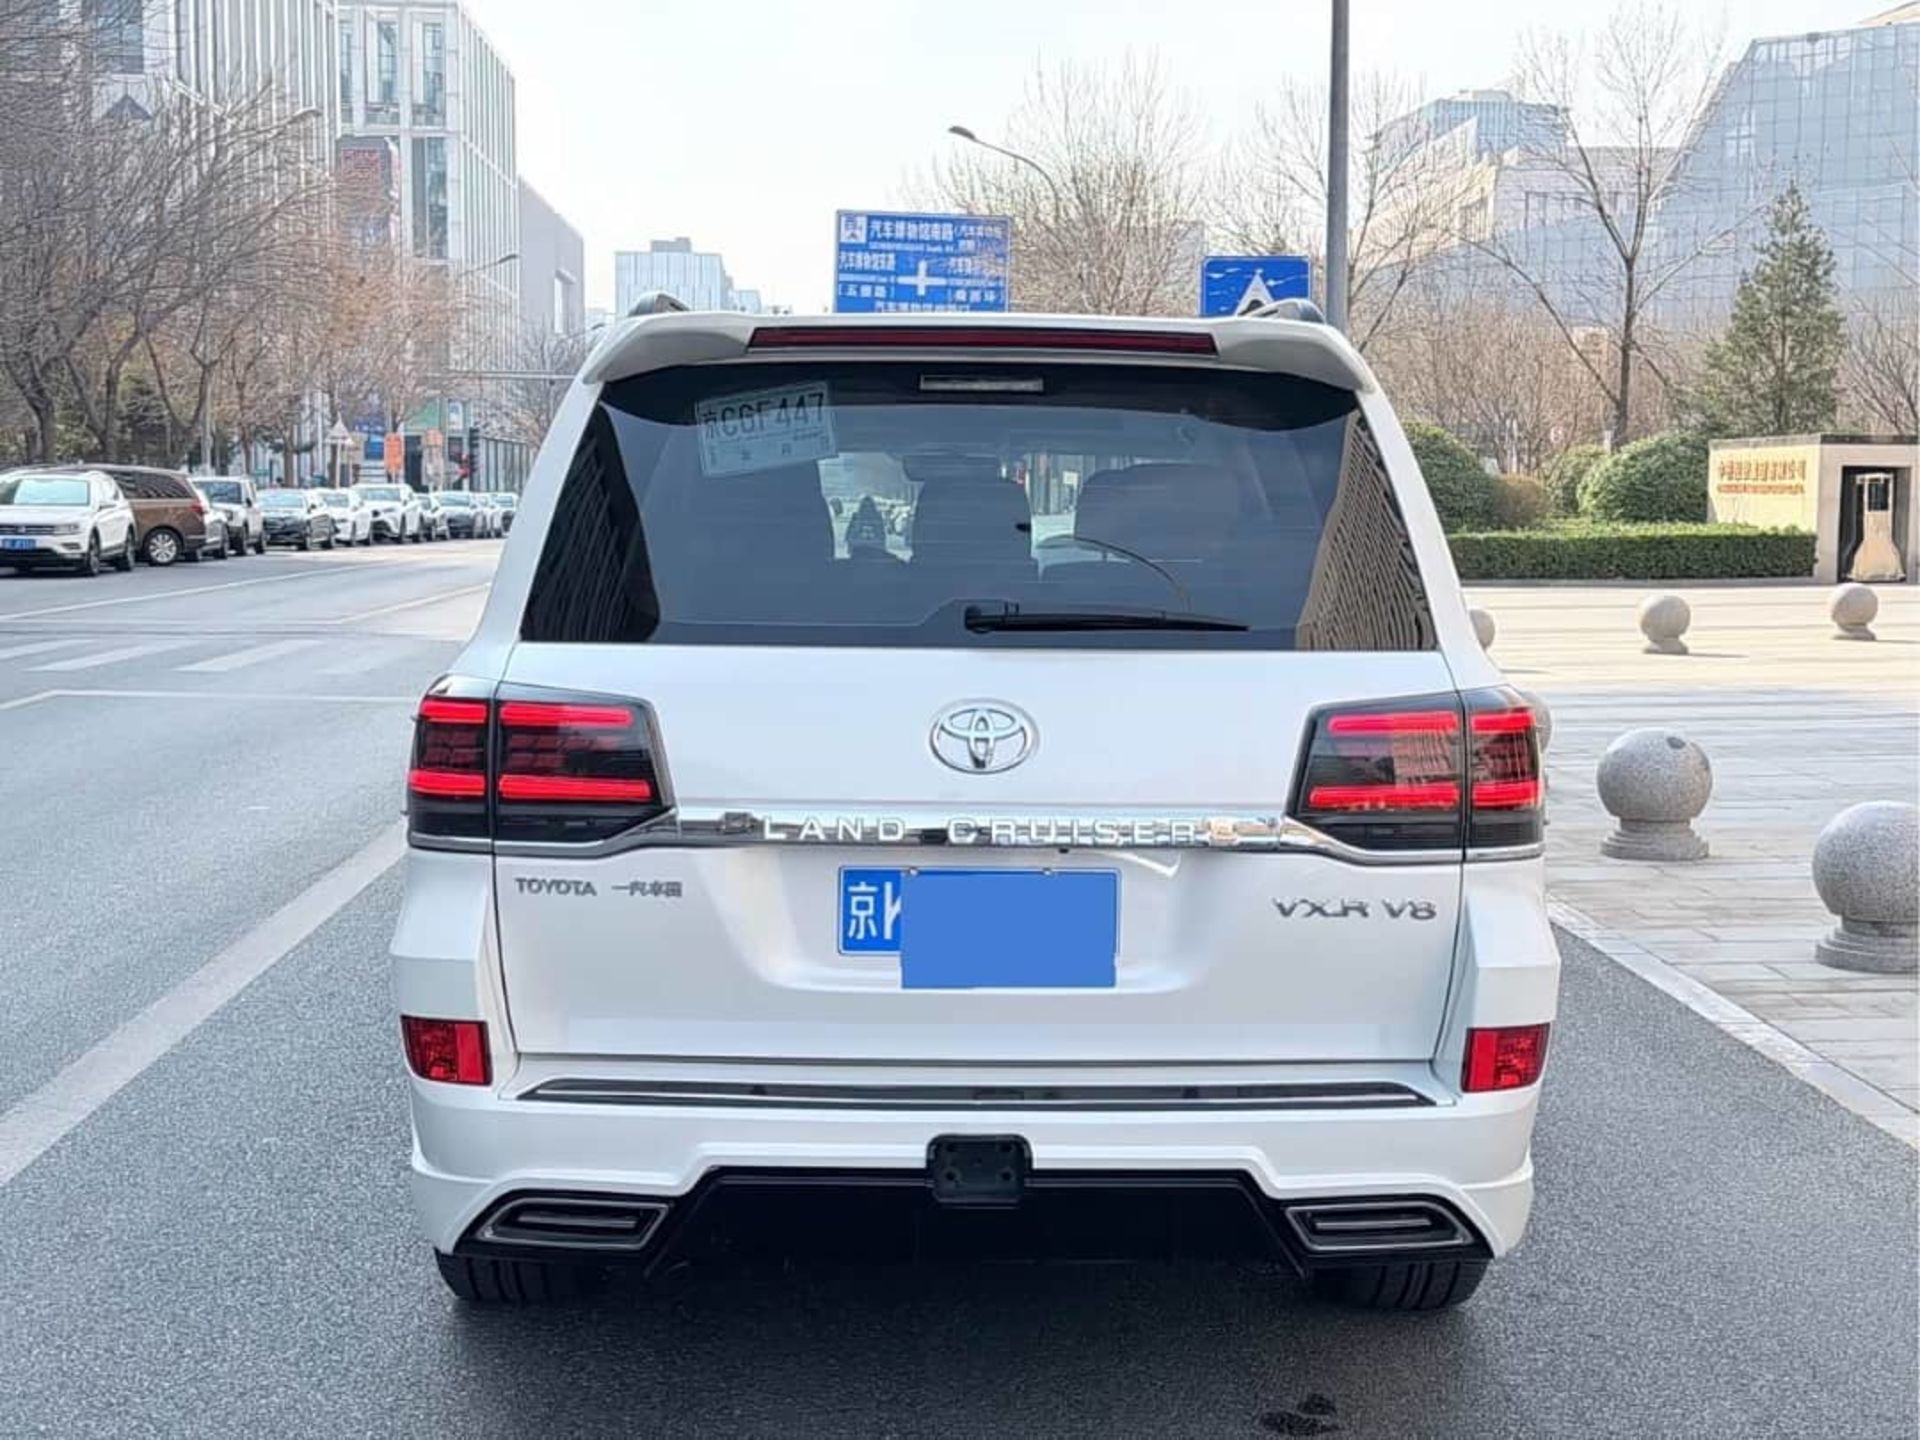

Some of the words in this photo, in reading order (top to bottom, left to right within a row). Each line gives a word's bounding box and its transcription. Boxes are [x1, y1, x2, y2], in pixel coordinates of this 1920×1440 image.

[763, 815, 906, 842] LAND
[947, 816, 1198, 847] CRUISER
[514, 877, 598, 897] TOYOTA
[1272, 897, 1370, 919] VXR
[1381, 898, 1438, 921] V8
